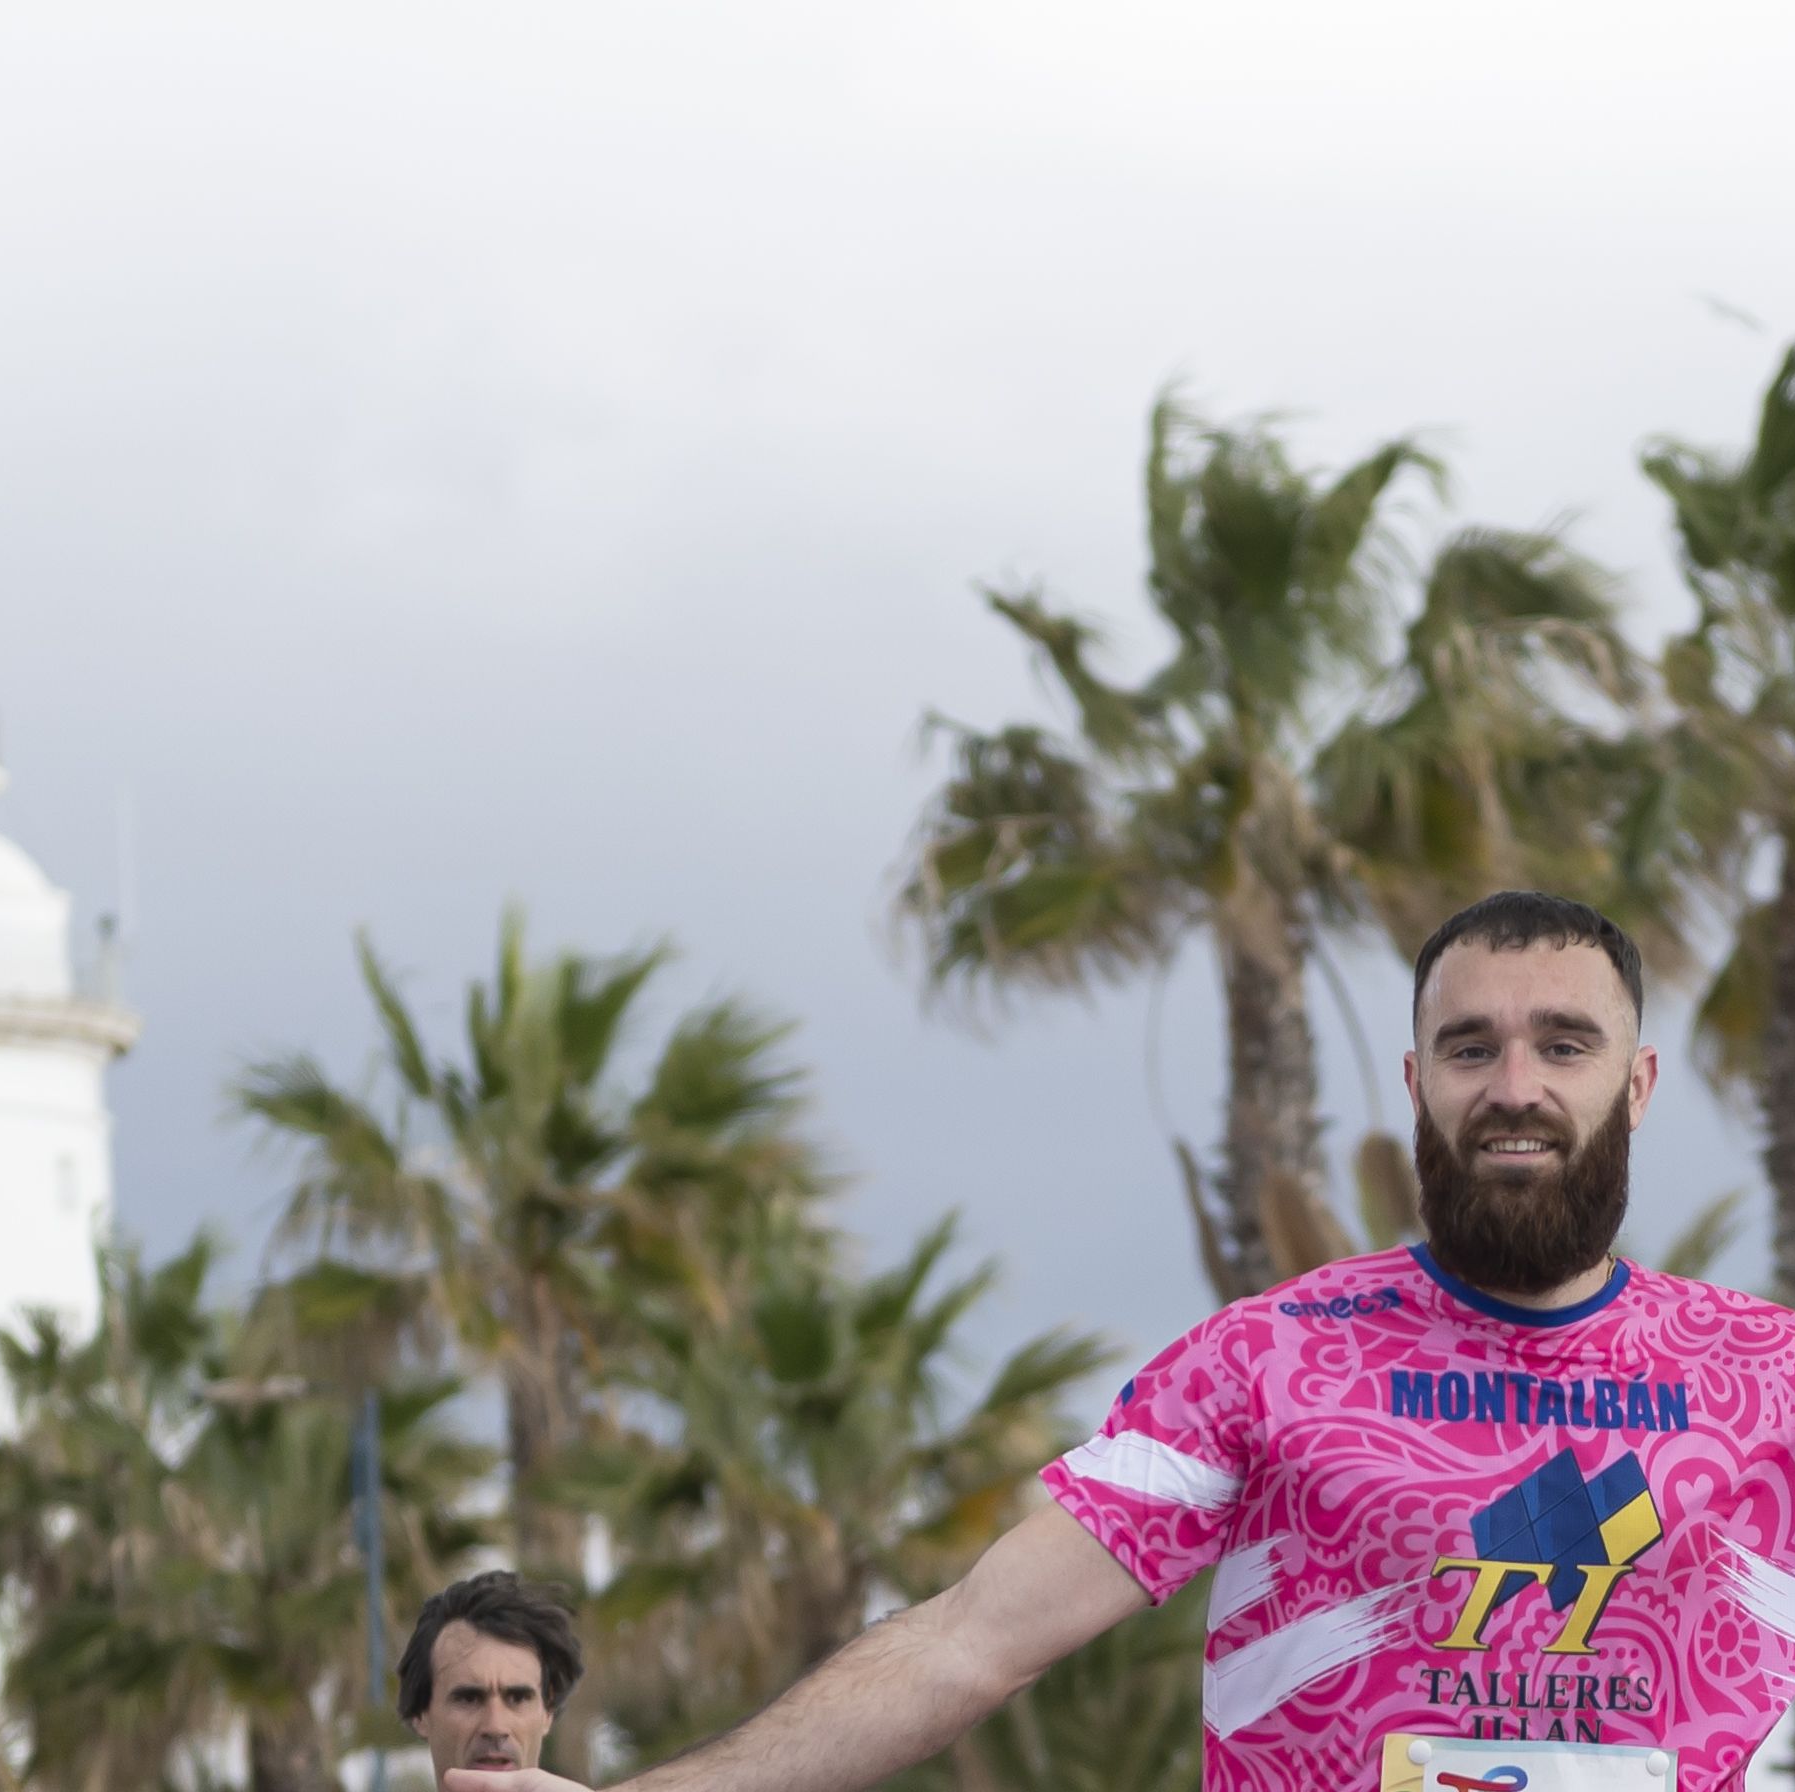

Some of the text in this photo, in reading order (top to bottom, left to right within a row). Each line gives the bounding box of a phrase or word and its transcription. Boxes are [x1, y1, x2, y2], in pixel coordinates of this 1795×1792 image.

[1390, 1370, 1690, 1432] MONTALBÁN
[1430, 1555, 1637, 1655] TI
[1420, 1669, 1653, 1711] TALLERES
